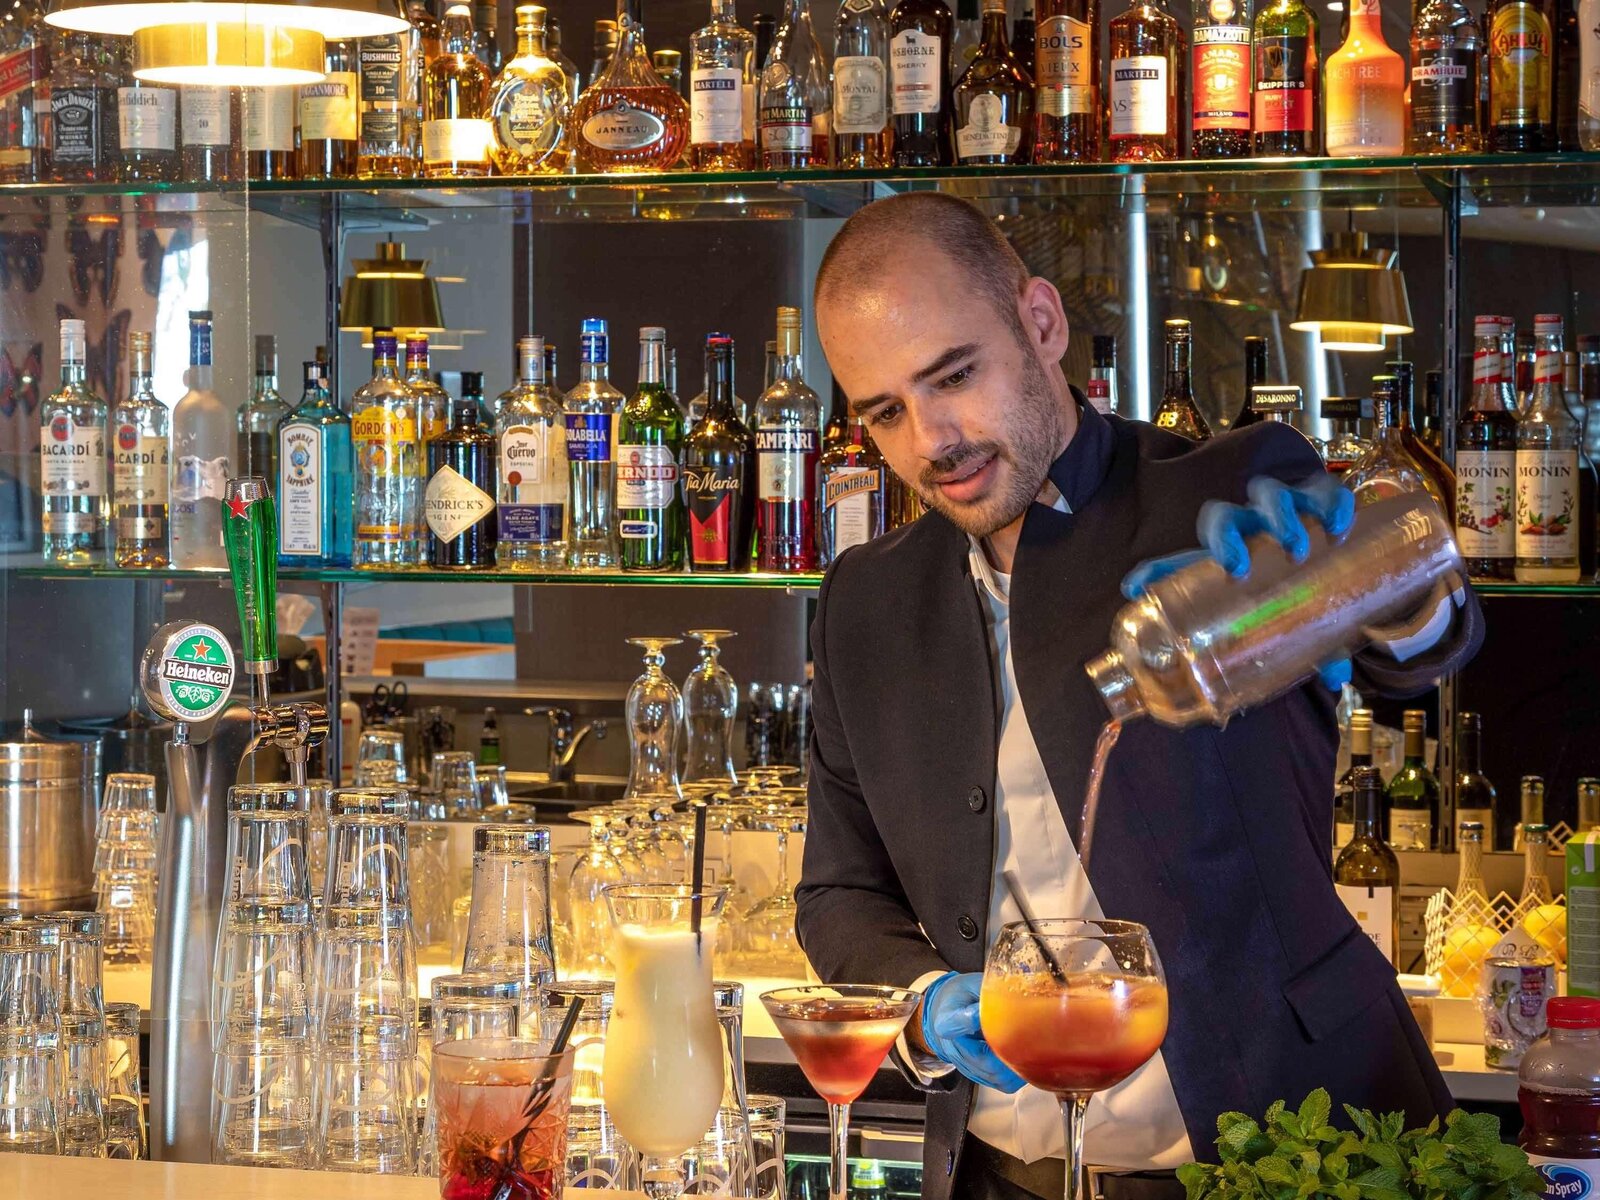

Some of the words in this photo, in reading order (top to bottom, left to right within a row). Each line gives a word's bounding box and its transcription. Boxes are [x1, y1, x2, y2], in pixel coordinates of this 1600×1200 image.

[1193, 28, 1250, 42] RAMAZZOTTI
[1039, 36, 1083, 49] BOLS
[1491, 28, 1549, 58] KAHLÚA
[361, 52, 401, 62] BUSHMILLS
[1202, 49, 1240, 61] AMARO
[1039, 61, 1080, 73] VIEUX
[1413, 67, 1465, 78] DRAMBUIE
[1115, 69, 1159, 81] MARTELL
[375, 86, 386, 95] 10
[694, 80, 734, 90] MARTELL
[841, 84, 878, 94] MONTAL
[52, 97, 69, 113] JACK
[1113, 100, 1127, 113] VS
[770, 107, 808, 119] MARTIN
[199, 118, 209, 129] 10
[596, 125, 648, 134] JANNEAU
[1255, 393, 1297, 404] DISARONNO
[354, 420, 405, 436] GORDON'S
[287, 432, 314, 447] BOMBAY
[756, 431, 813, 450] CAMPARI
[42, 441, 90, 456] BACARDÍ
[506, 445, 536, 460] Cuervo
[617, 465, 673, 479] ERNOD
[1458, 467, 1511, 478] MONIN
[1519, 466, 1572, 478] MONIN
[286, 474, 315, 487] SAPPHIRE
[683, 469, 700, 492] Tia
[697, 470, 739, 493] Maria
[828, 474, 875, 500] COINTREAU
[426, 500, 484, 510] ENDRICK'S
[166, 661, 231, 685] Heineken
[334, 861, 355, 931] Heineke
[1555, 1179, 1583, 1198] Spray
